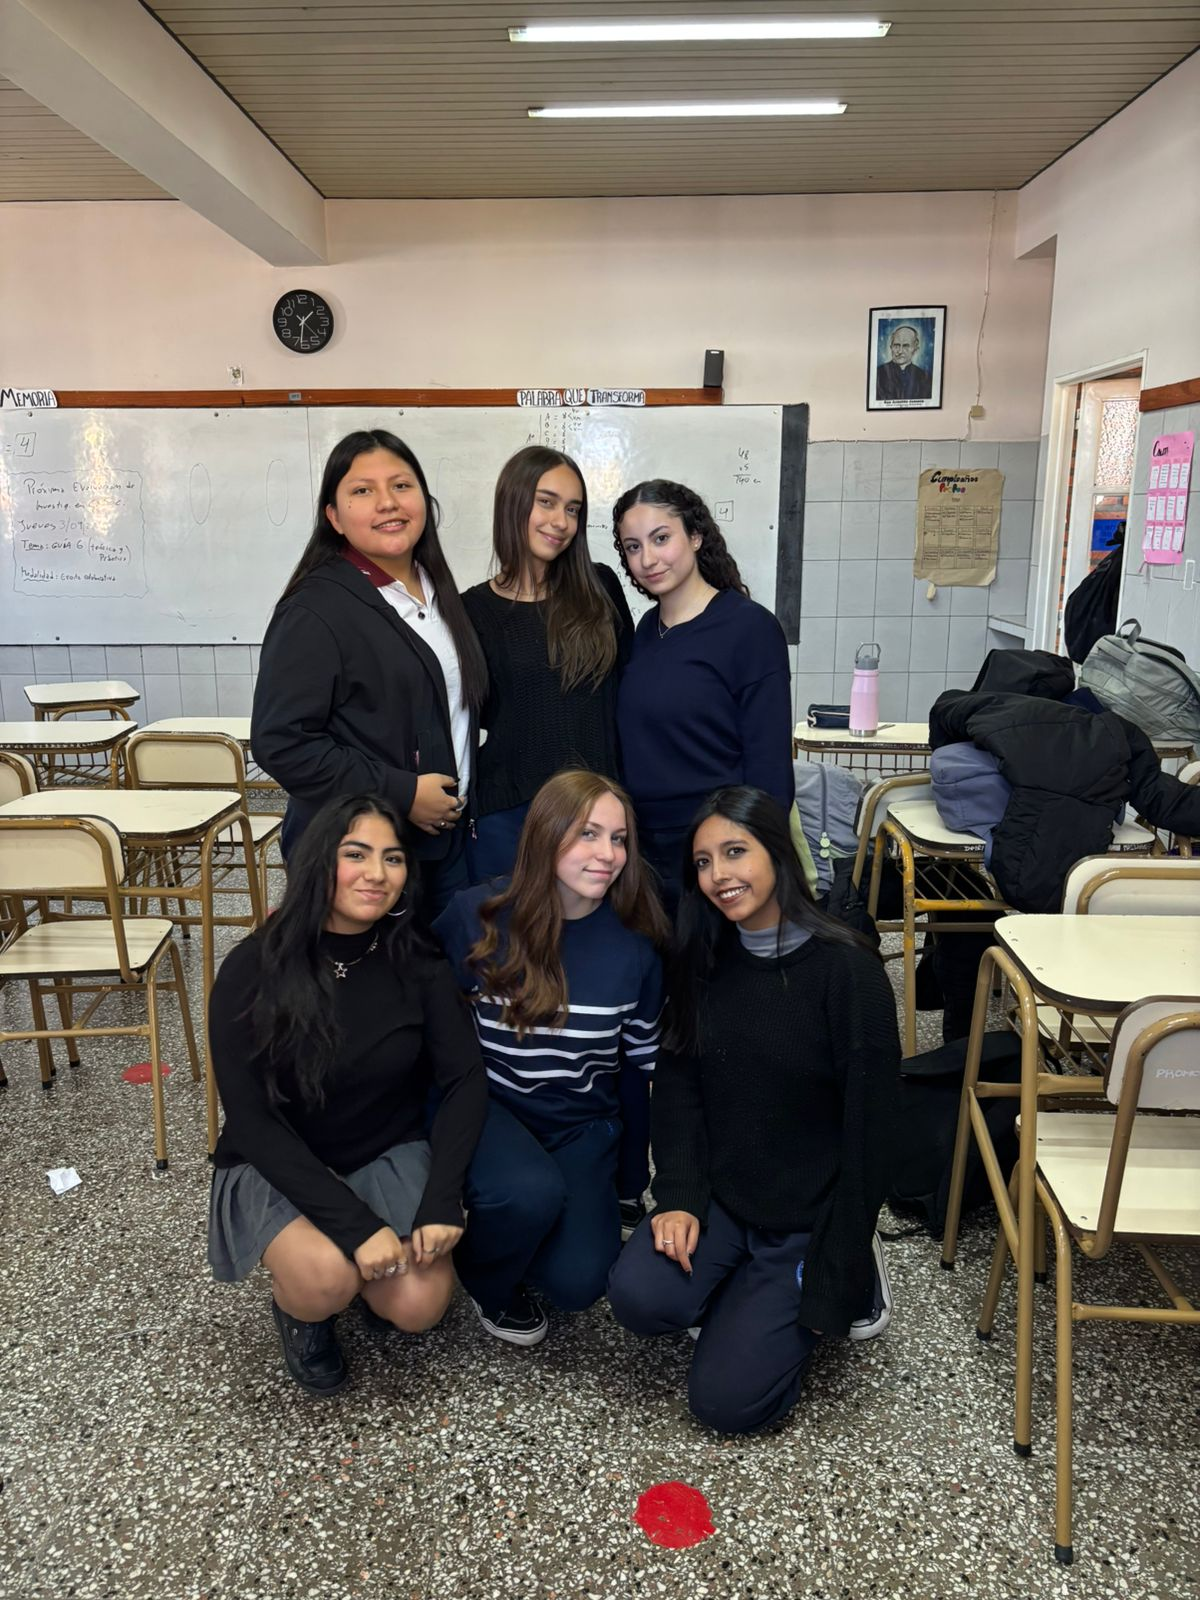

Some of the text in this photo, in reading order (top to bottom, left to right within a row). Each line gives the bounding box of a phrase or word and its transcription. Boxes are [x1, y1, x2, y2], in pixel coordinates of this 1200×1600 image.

[296, 294, 308, 304] 12
[310, 298, 315, 306] 1
[281, 307, 294, 317] 10
[316, 305, 325, 316] 2
[278, 317, 287, 327] 9
[320, 317, 330, 327] 3
[282, 328, 292, 338] 8
[317, 328, 327, 337] 4
[292, 336, 301, 346] 7
[300, 340, 310, 350] 6
[310, 336, 320, 346] 5
[0, 388, 56, 407] MEMORIA
[520, 388, 645, 406] PALABRA QUE TRANSFORMA
[76, 540, 84, 550] 6
